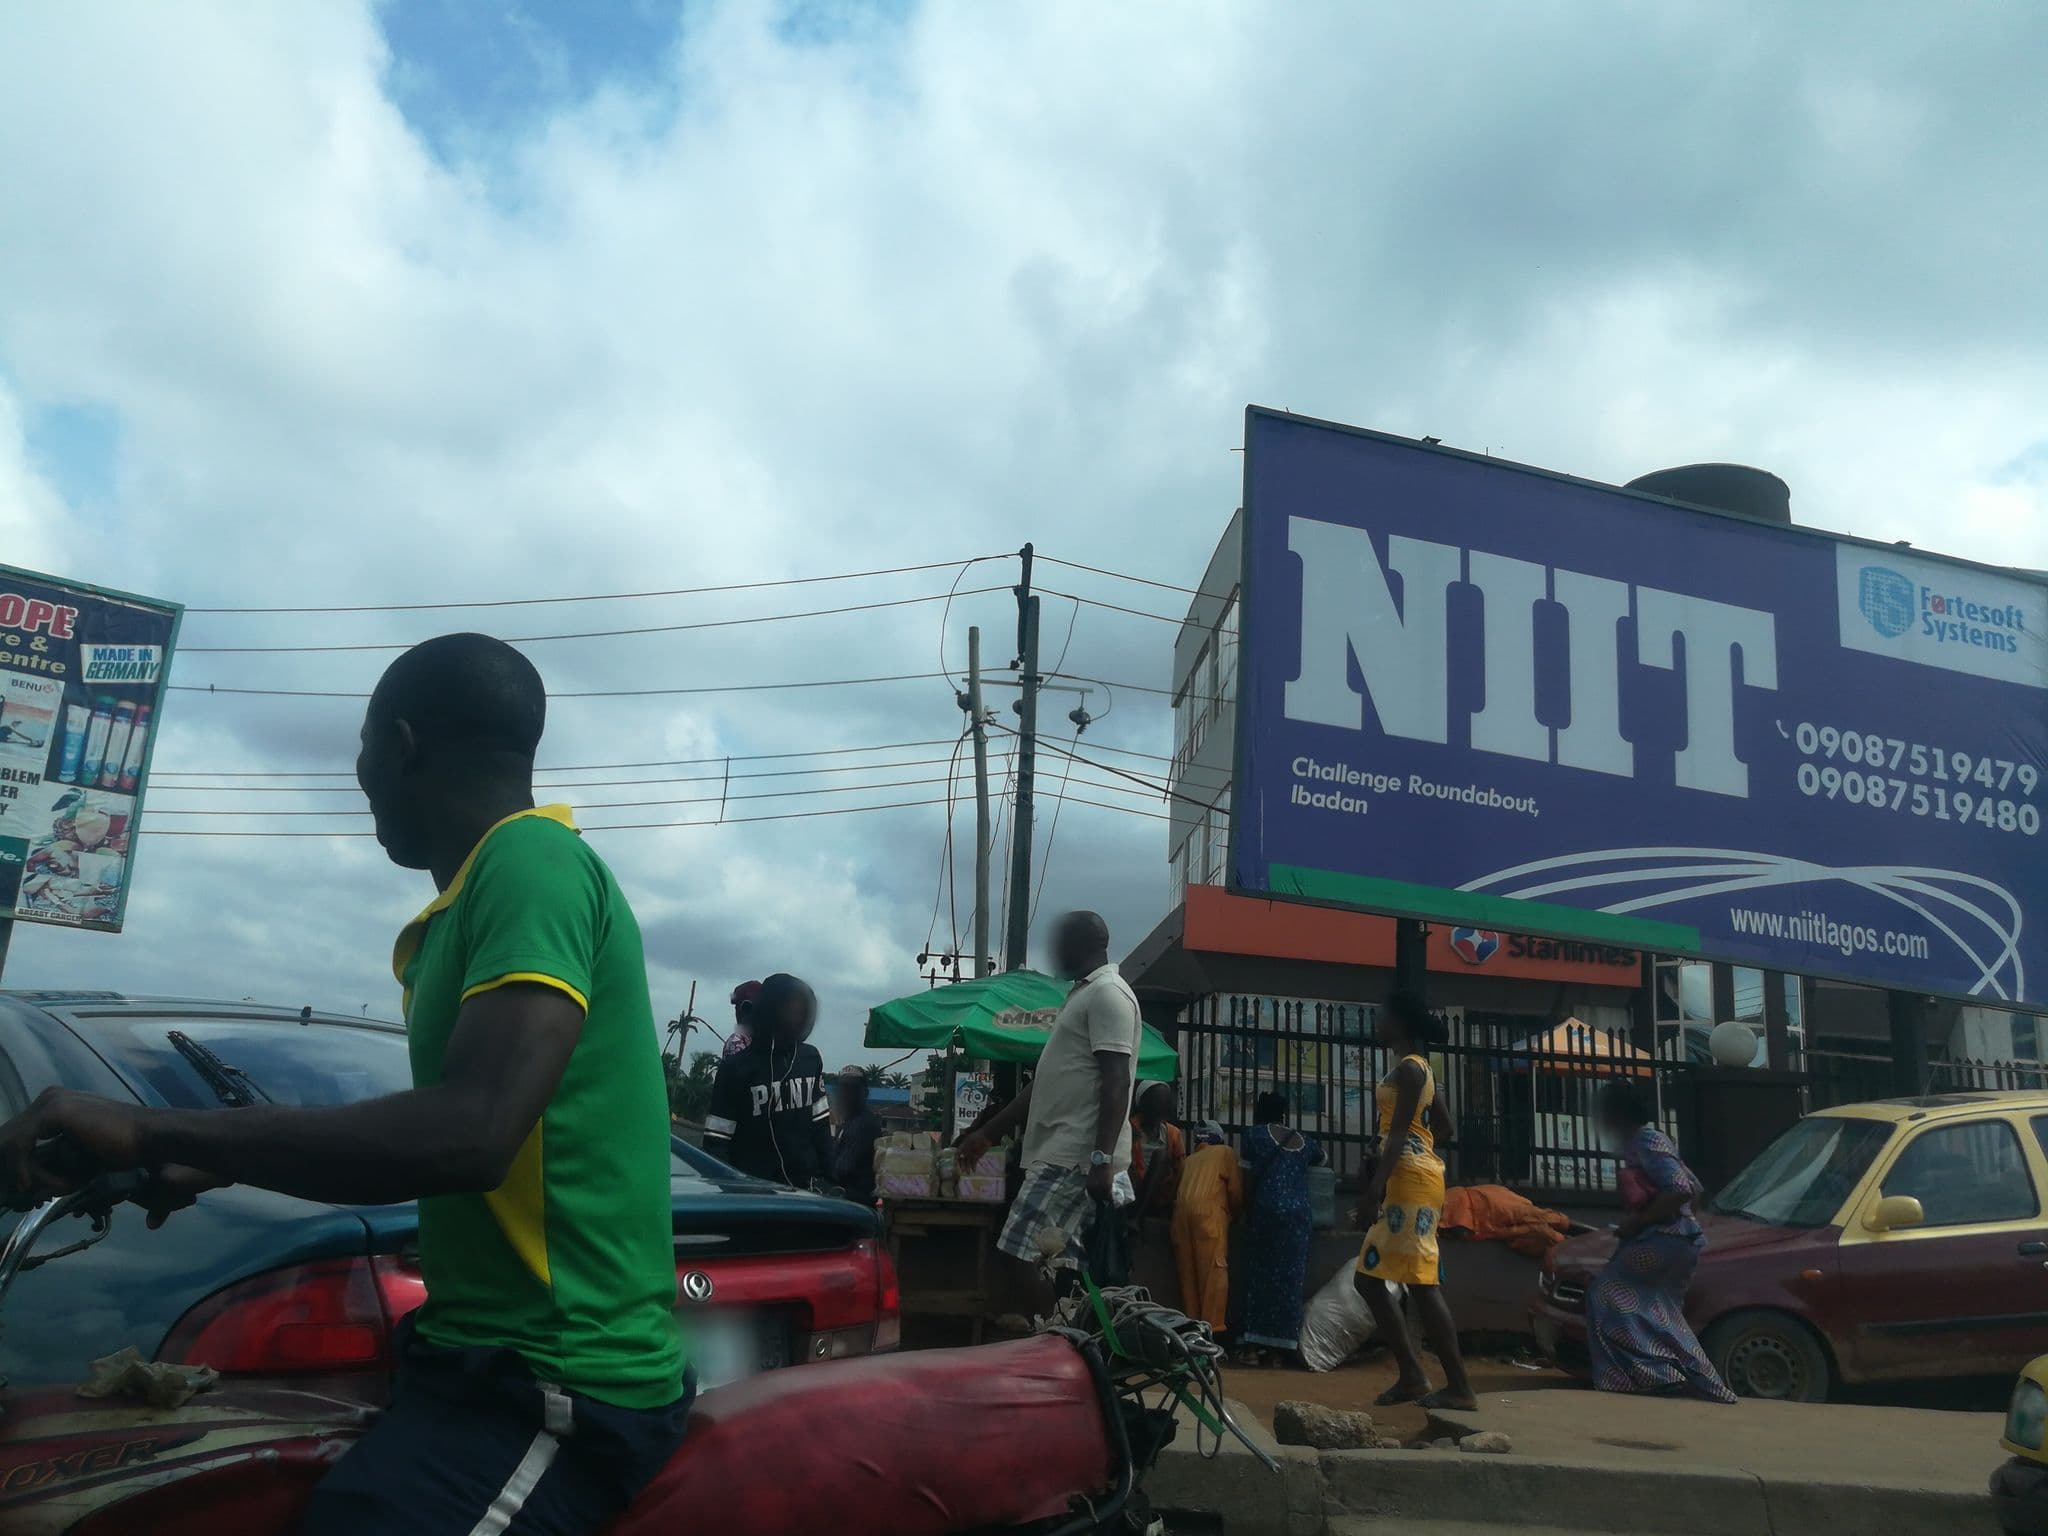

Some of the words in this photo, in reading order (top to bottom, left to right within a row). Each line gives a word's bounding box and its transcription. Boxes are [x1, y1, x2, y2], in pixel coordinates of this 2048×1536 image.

[0, 593, 79, 639] OPE
[1920, 586, 2024, 631] Fortesoft
[30, 636, 48, 653] &
[93, 647, 135, 661] MADE
[138, 648, 153, 661] IN
[1921, 612, 2017, 653] Systems
[85, 662, 160, 680] GERMANY
[1284, 516, 1778, 798] NIIT
[11, 679, 42, 692] BENU
[0, 767, 41, 785] BLEM
[1796, 722, 2037, 796] 09087519479
[1291, 757, 1401, 794] Challenge
[1408, 775, 1539, 817] Roundabout,
[1291, 784, 1368, 814] Ibadan
[1797, 763, 2040, 836] 09087519480
[1730, 907, 1929, 959] www.niitlagos.com
[0, 1436, 158, 1490] OXER
